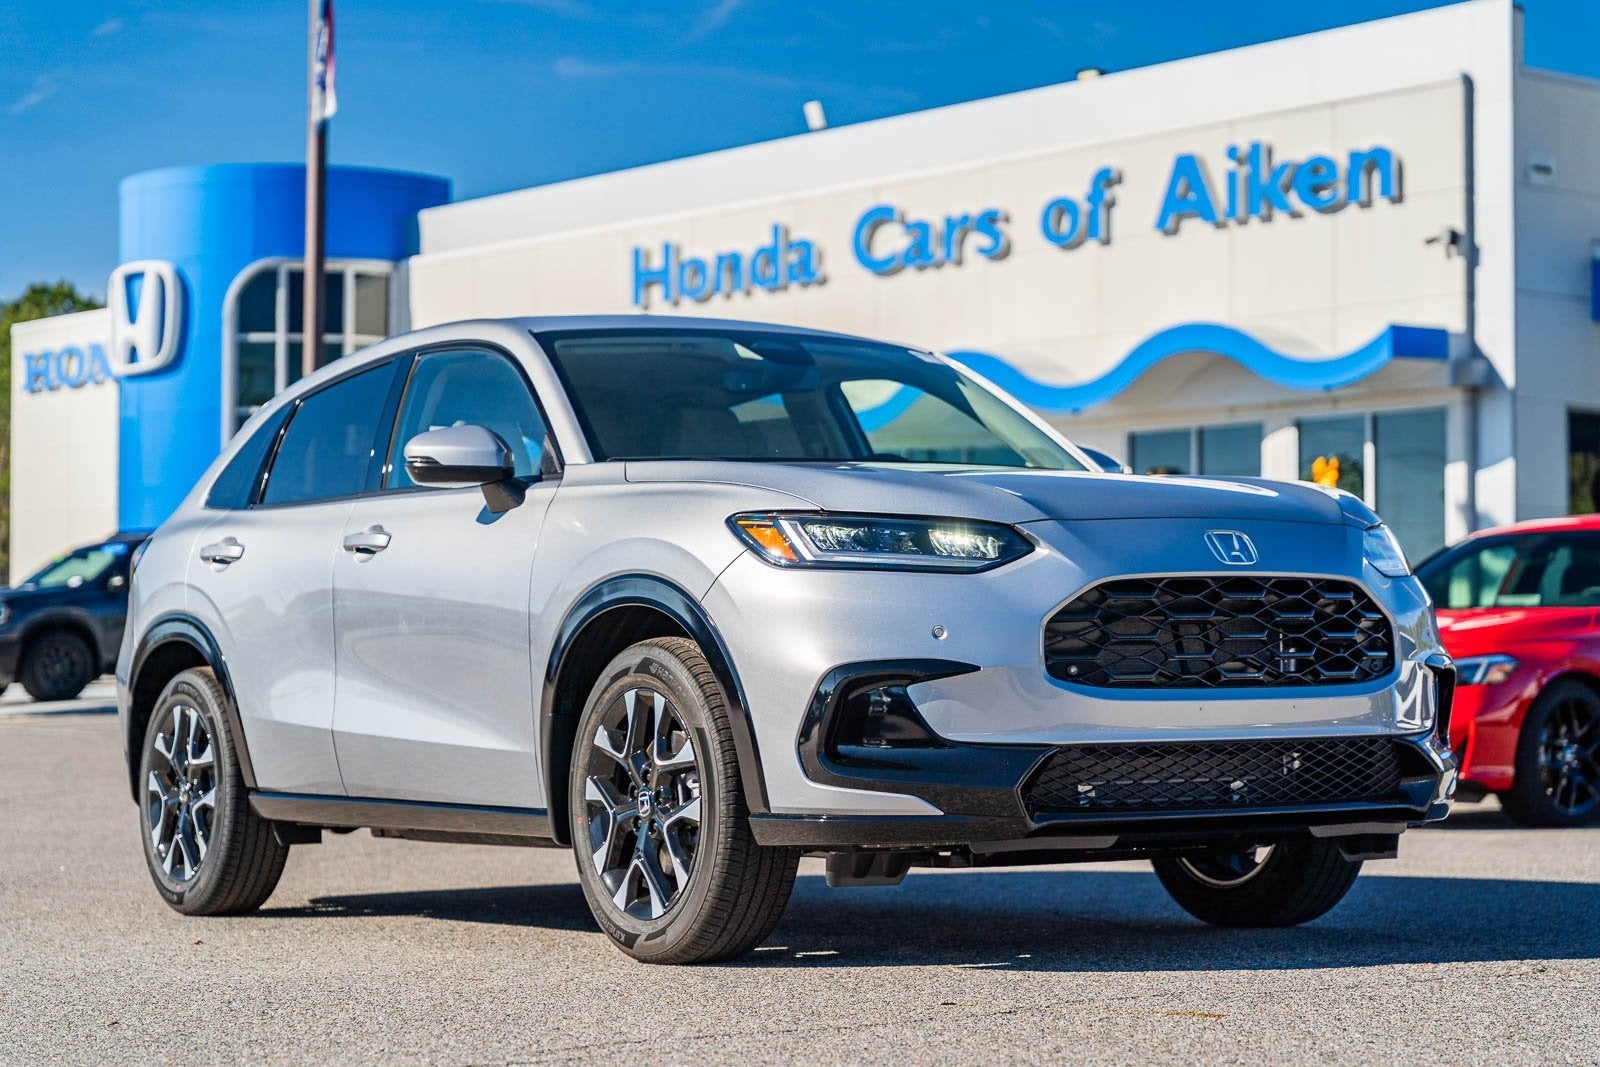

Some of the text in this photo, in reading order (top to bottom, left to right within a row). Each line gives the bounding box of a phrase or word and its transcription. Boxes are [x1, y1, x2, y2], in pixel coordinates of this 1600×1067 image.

[632, 140, 1402, 306] Honda Cars of Aiken
